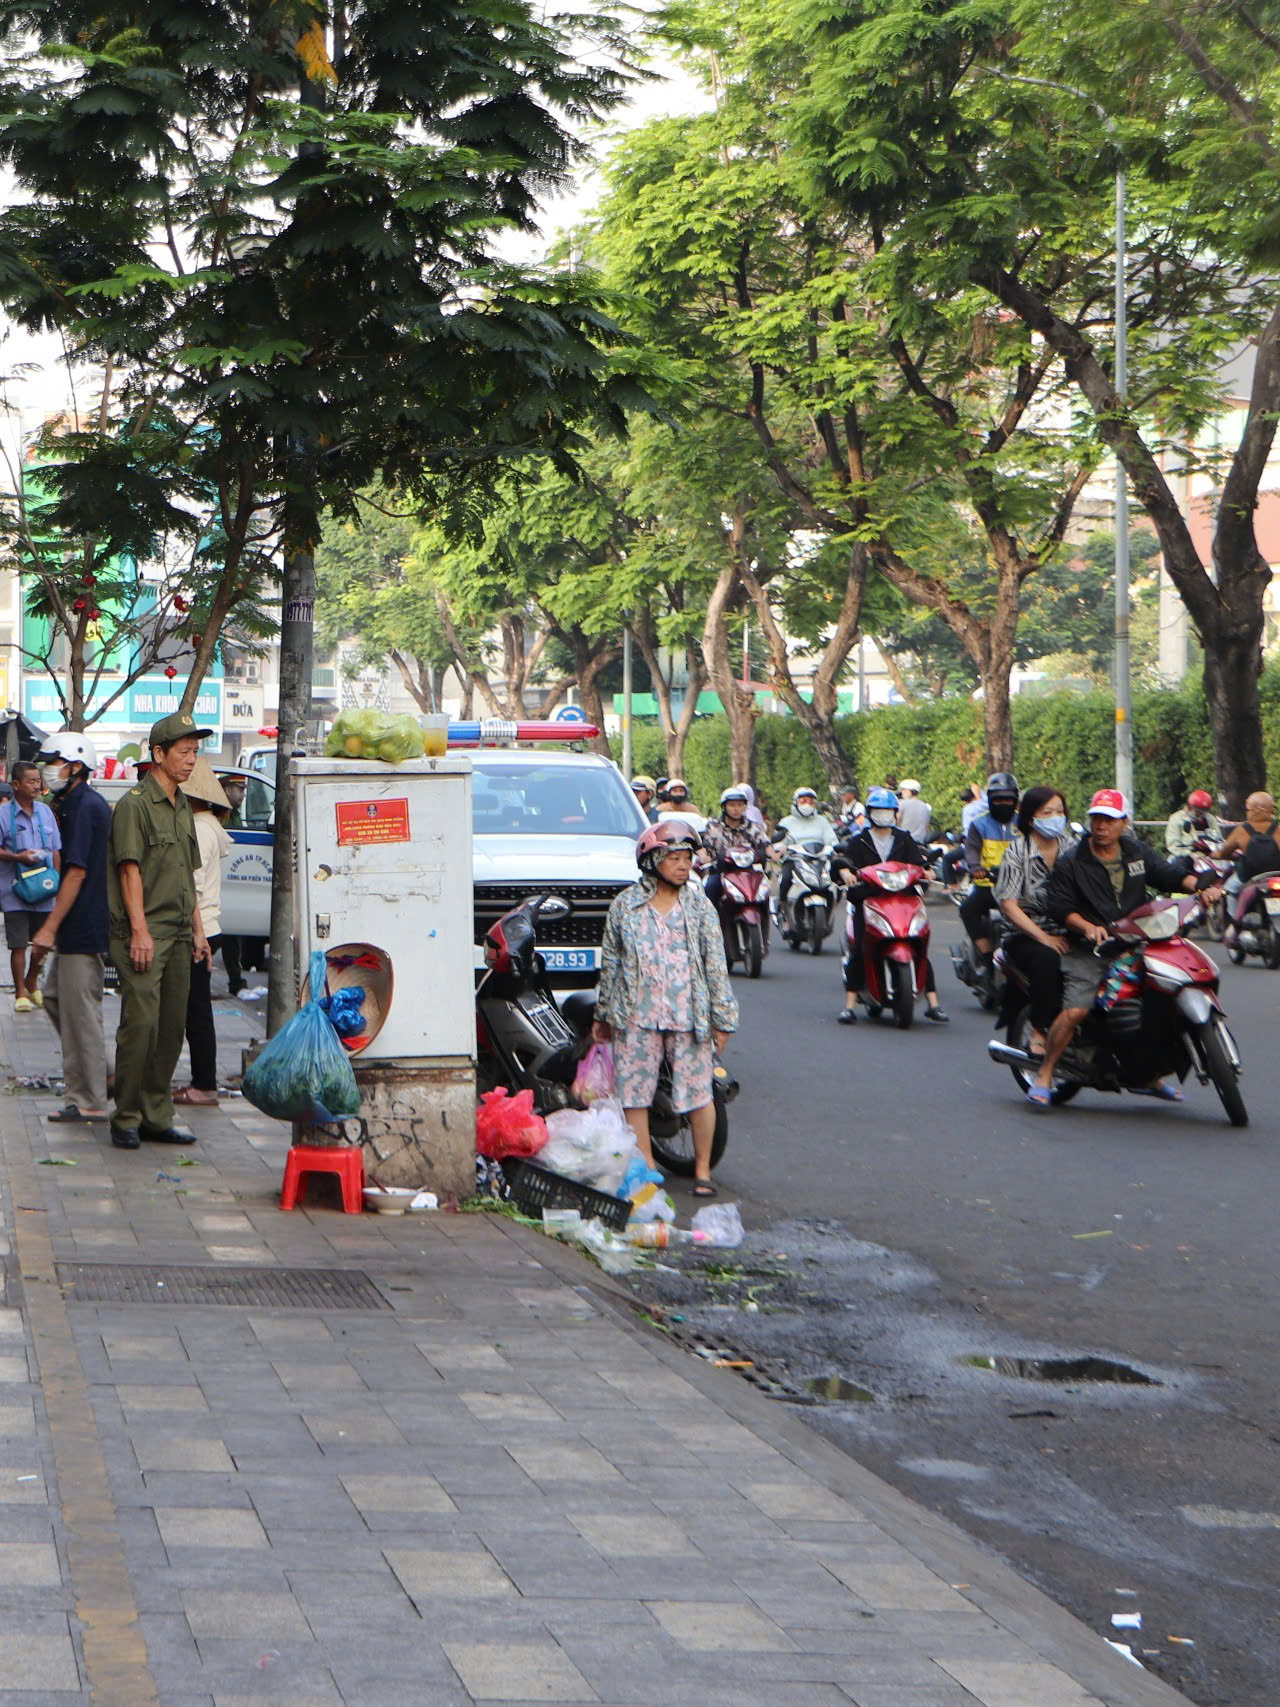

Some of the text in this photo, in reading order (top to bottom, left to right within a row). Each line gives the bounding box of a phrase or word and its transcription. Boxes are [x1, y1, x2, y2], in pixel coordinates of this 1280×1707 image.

[134, 695, 153, 713] NHA
[155, 695, 179, 713] KHOA
[541, 952, 585, 967] 28.93
